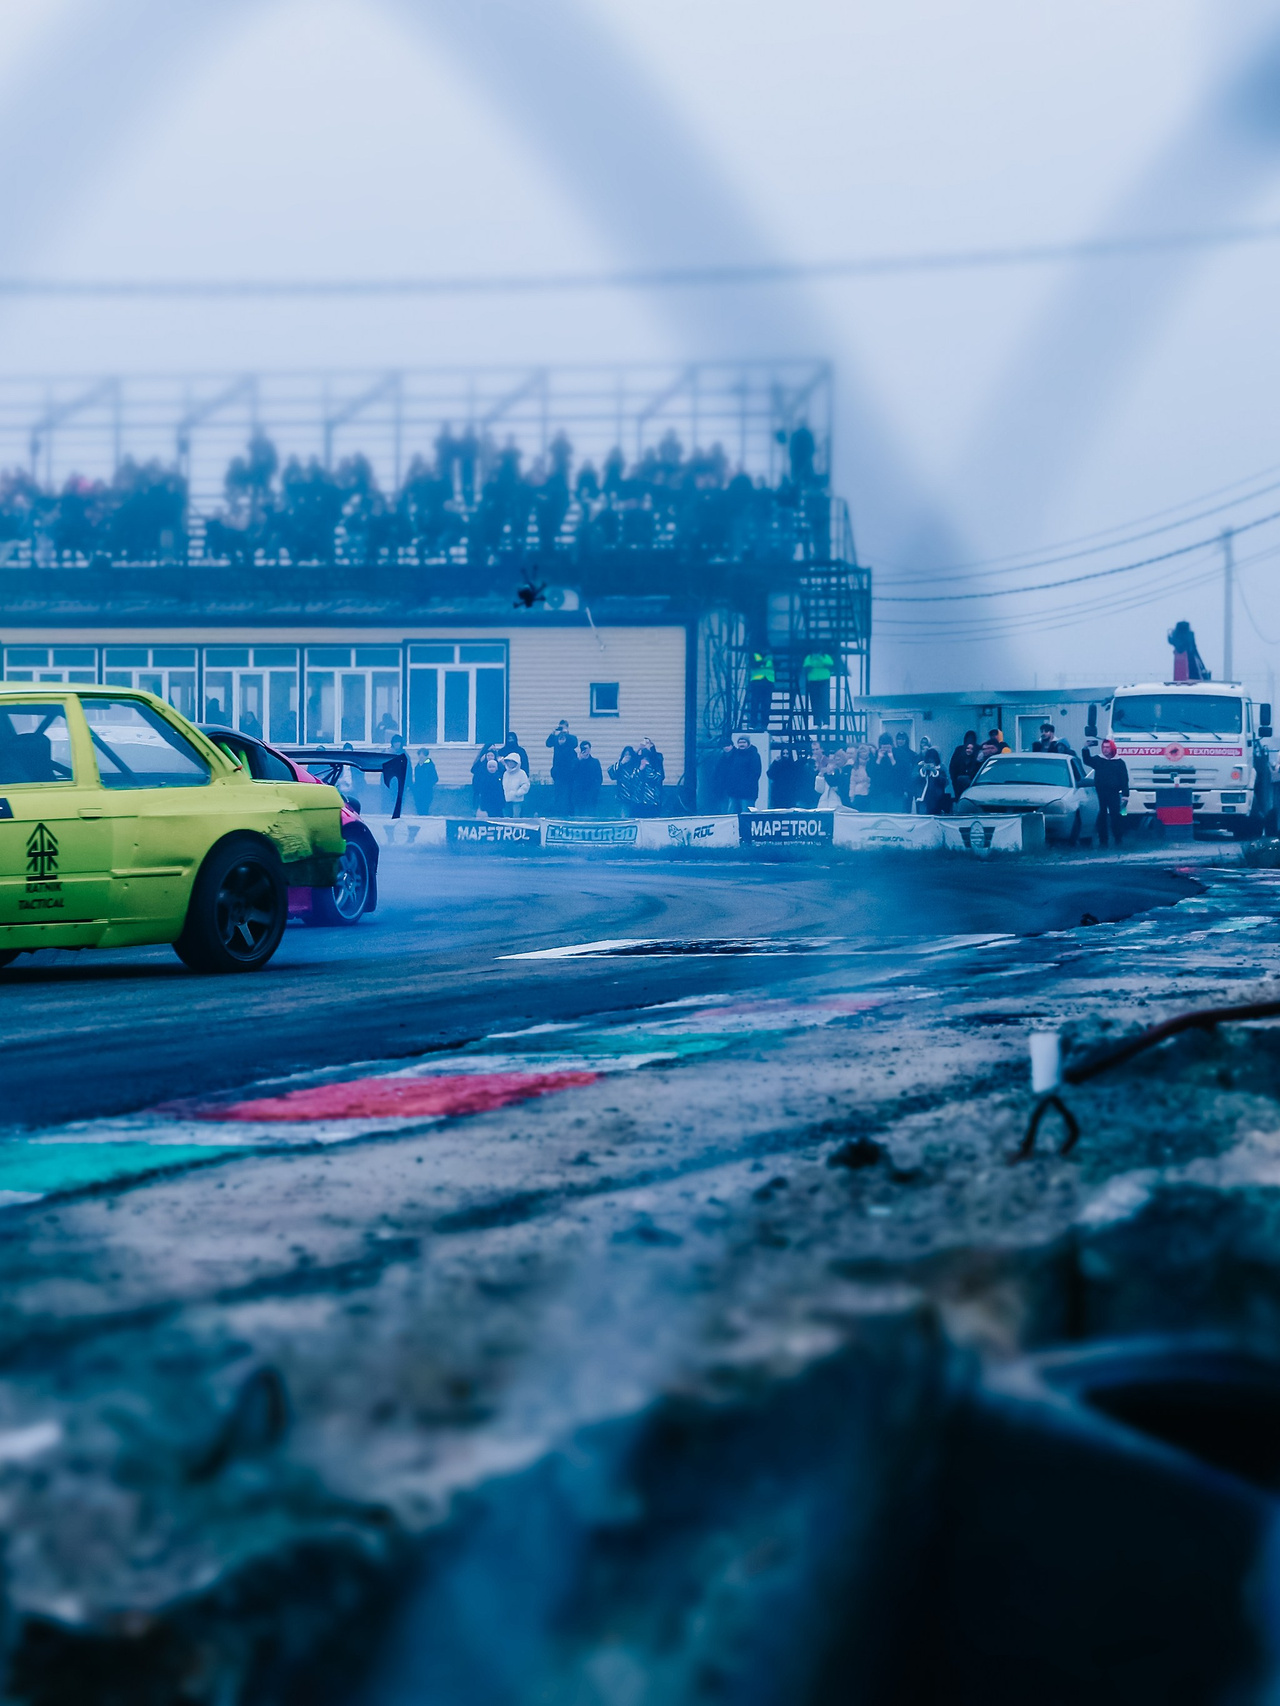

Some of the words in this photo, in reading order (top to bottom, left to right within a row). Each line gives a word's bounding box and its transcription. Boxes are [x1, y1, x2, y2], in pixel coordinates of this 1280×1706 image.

[1188, 748, 1241, 757] ТЕХПОМОЩЬ
[457, 825, 531, 841] MAPETROL
[751, 819, 826, 836] MAPETROL
[18, 898, 65, 910] TACTICAL
